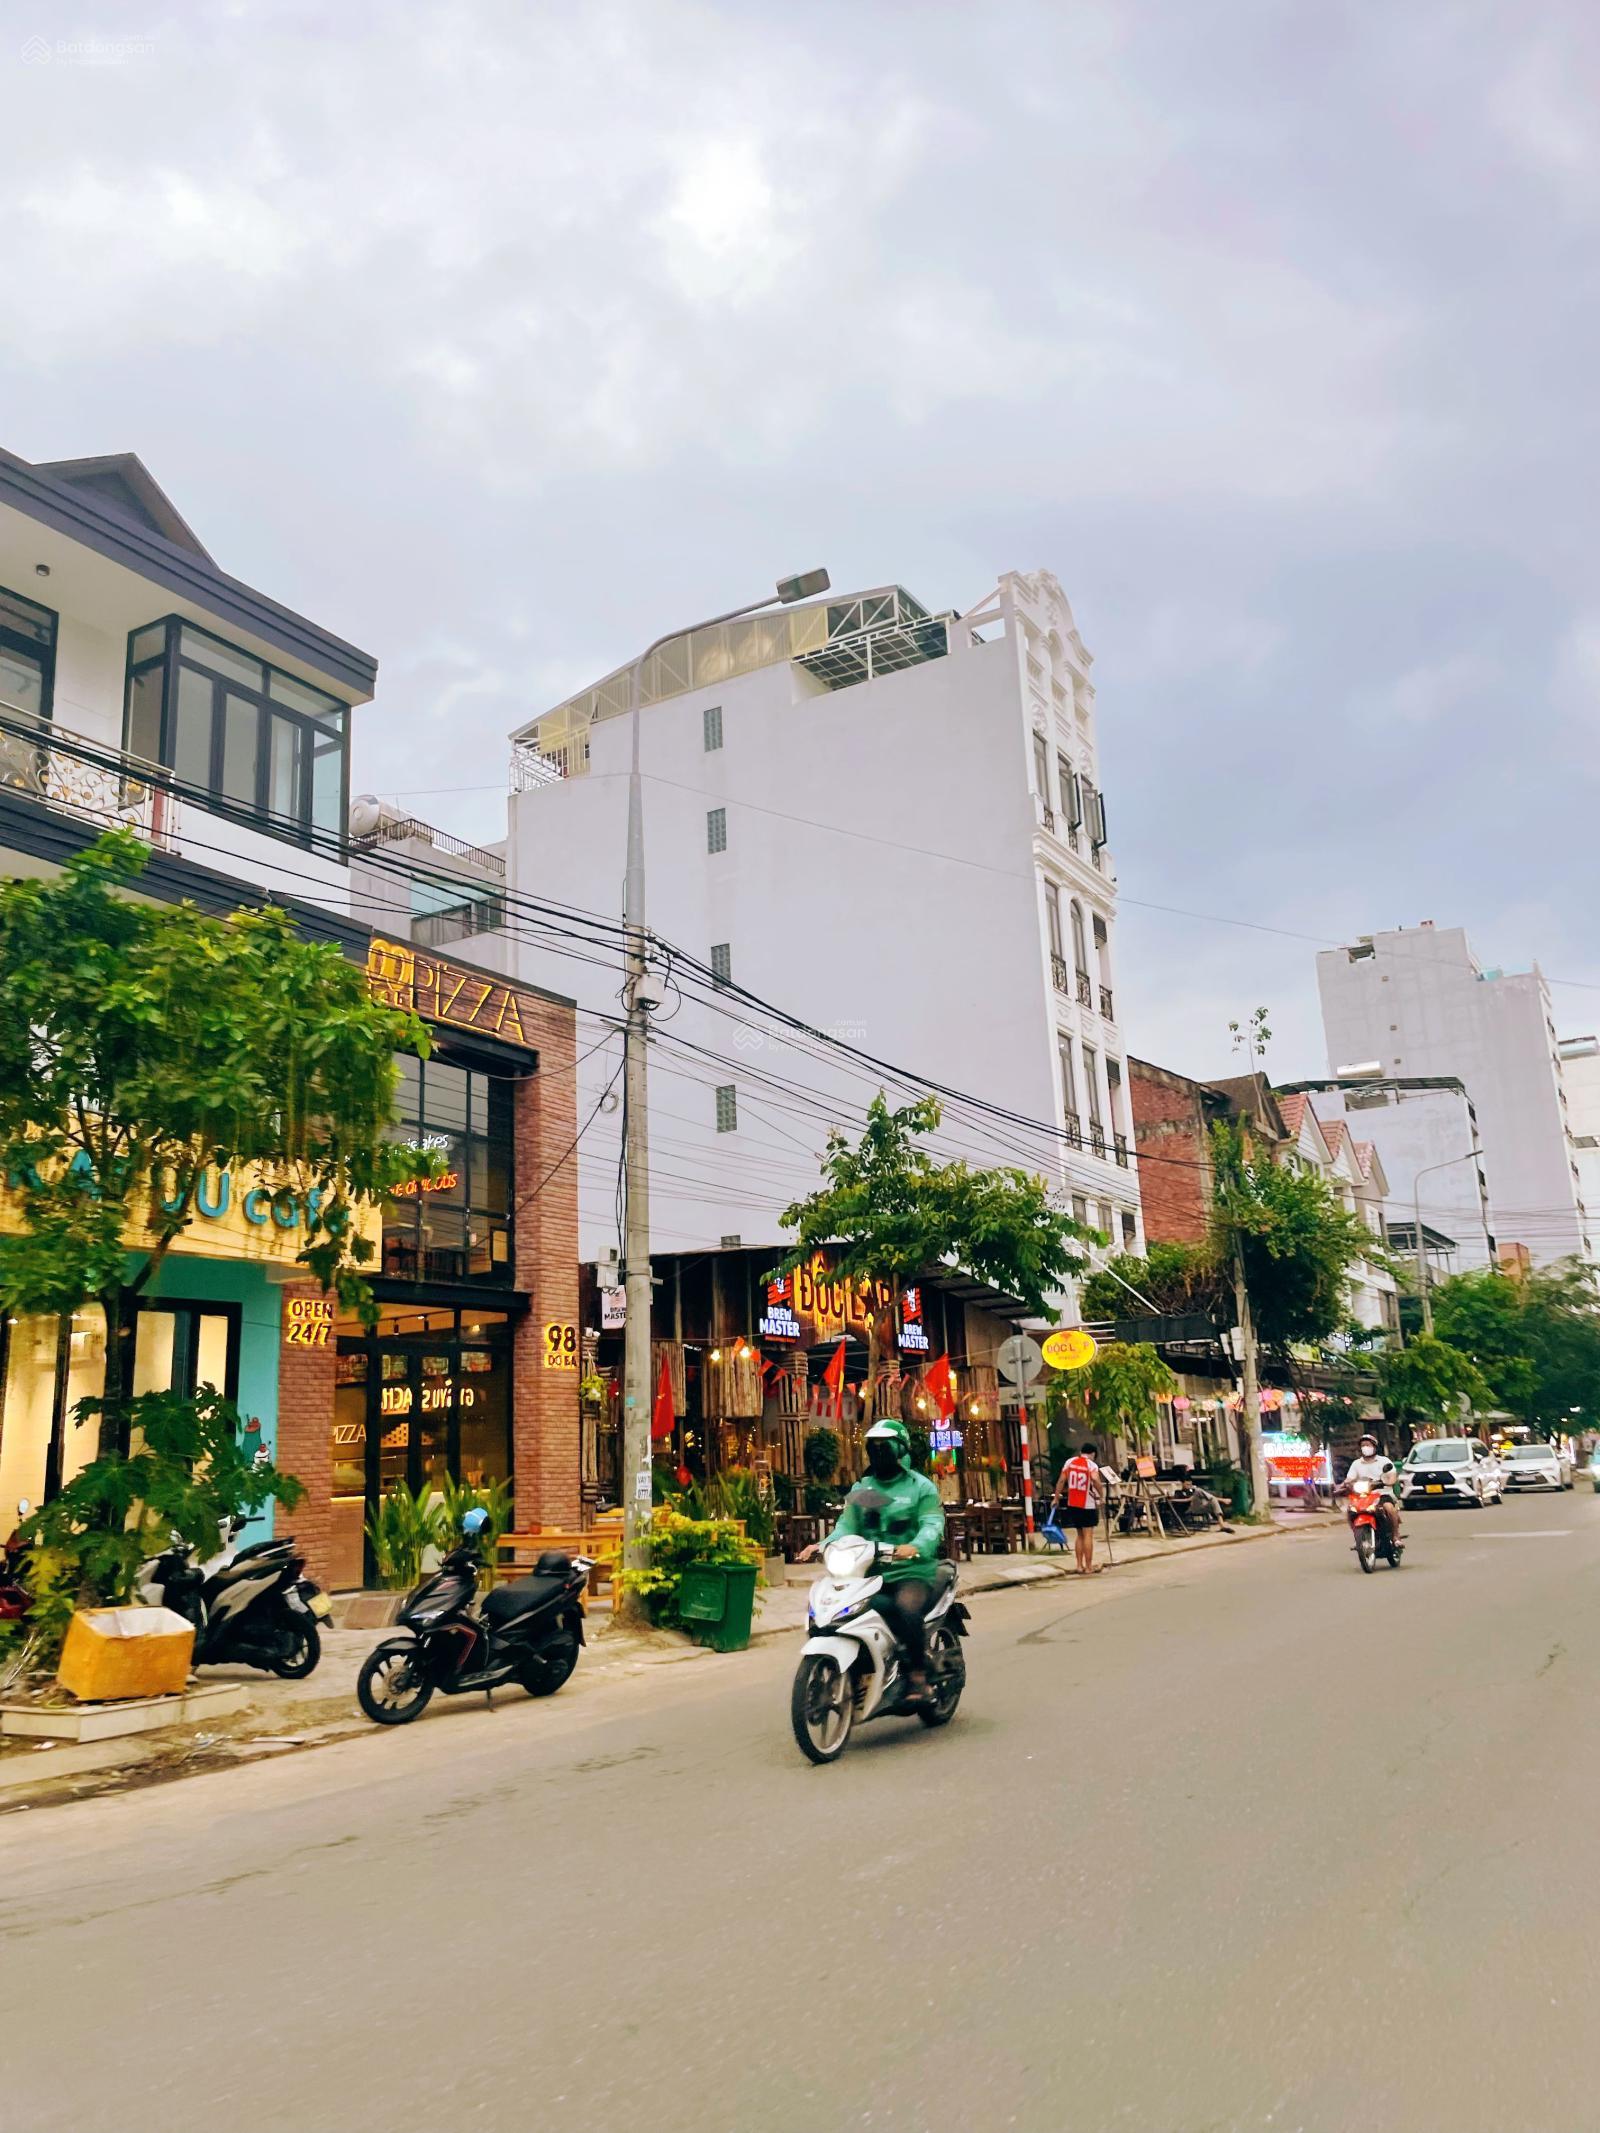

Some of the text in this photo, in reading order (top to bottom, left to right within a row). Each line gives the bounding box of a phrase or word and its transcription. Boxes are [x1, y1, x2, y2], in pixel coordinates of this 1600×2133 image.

[292, 1300, 334, 1318] OPEN
[767, 1306, 792, 1320] BREW
[290, 1322, 332, 1344] 24/7
[759, 1317, 801, 1337] MASTER
[903, 1323, 923, 1336] BREW
[548, 1325, 577, 1353] 98
[898, 1333, 929, 1350] MASTER
[1068, 1470, 1088, 1491] 02
